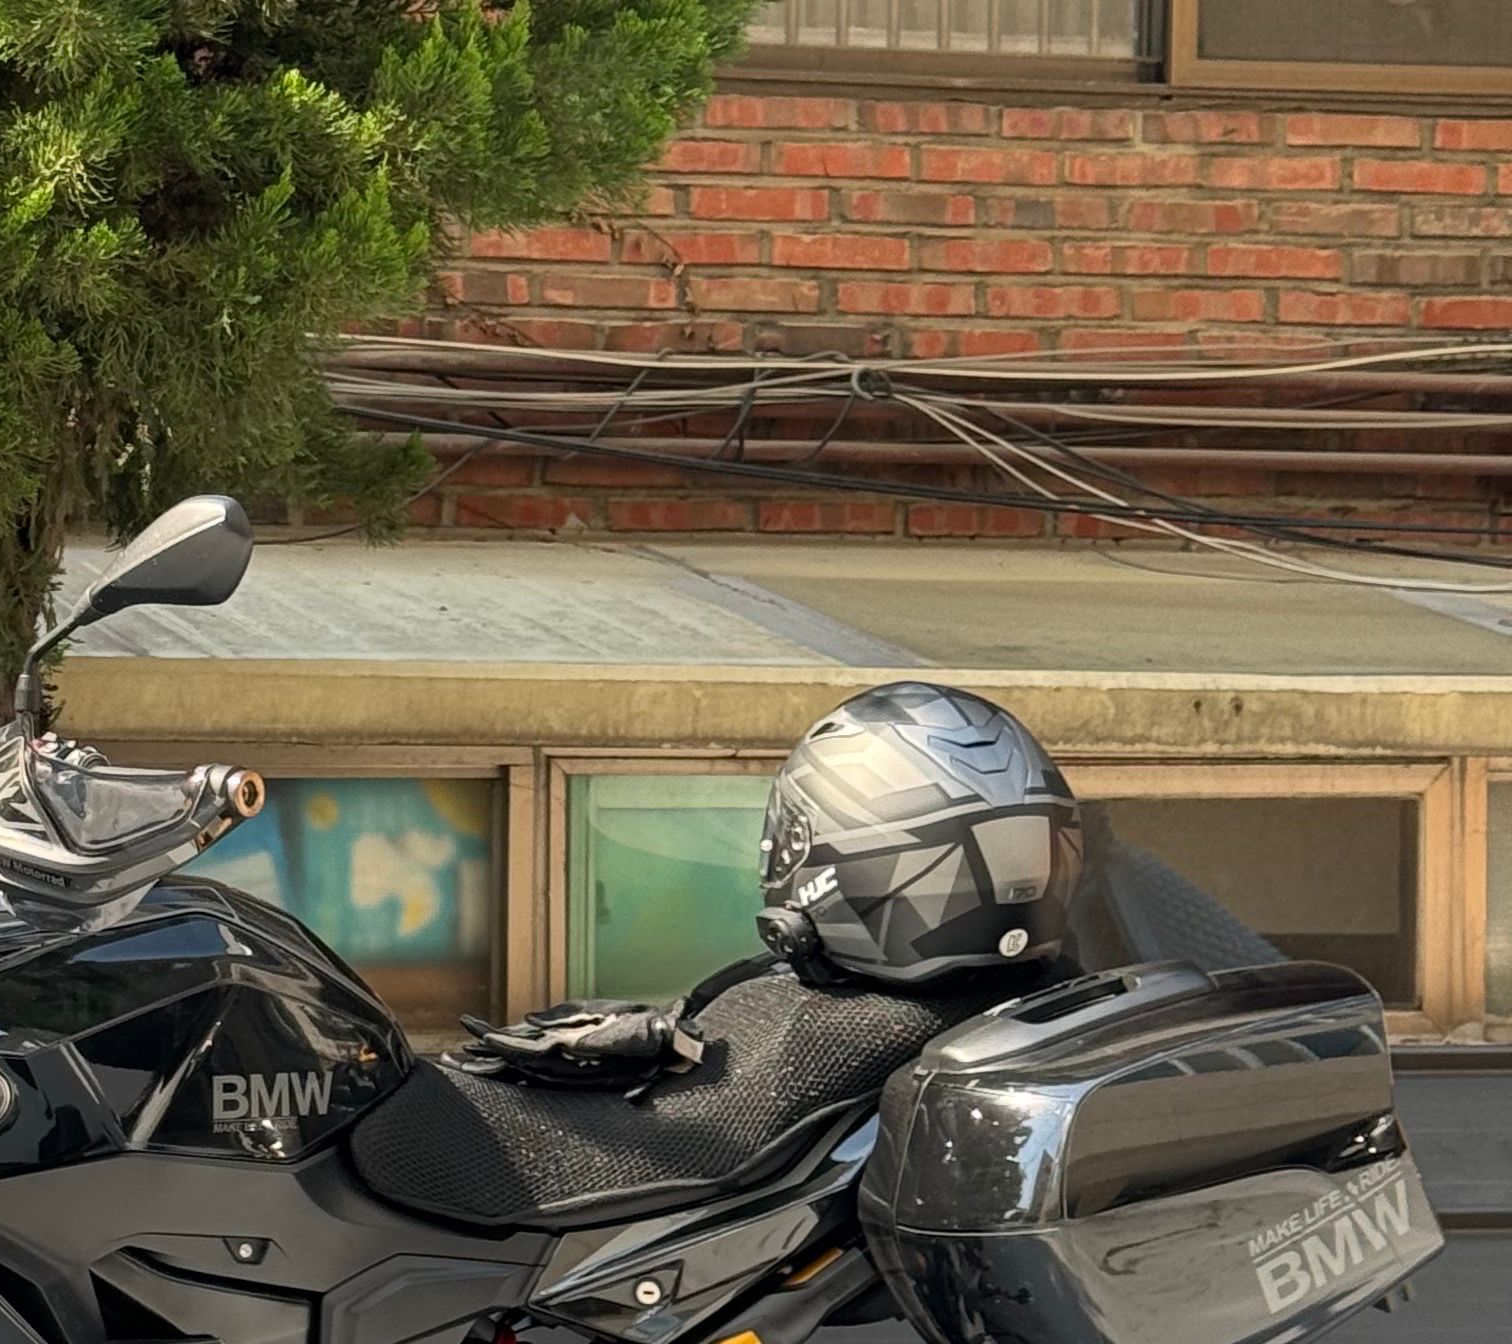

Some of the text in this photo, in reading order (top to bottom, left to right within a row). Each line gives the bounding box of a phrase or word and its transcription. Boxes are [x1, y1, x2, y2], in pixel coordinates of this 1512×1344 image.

[798, 866, 838, 906] HJC
[212, 1071, 334, 1119] BMW
[1248, 1212, 1303, 1257] MAKE
[1304, 1189, 1344, 1227] LIFE
[1256, 1178, 1411, 1315] BMW
